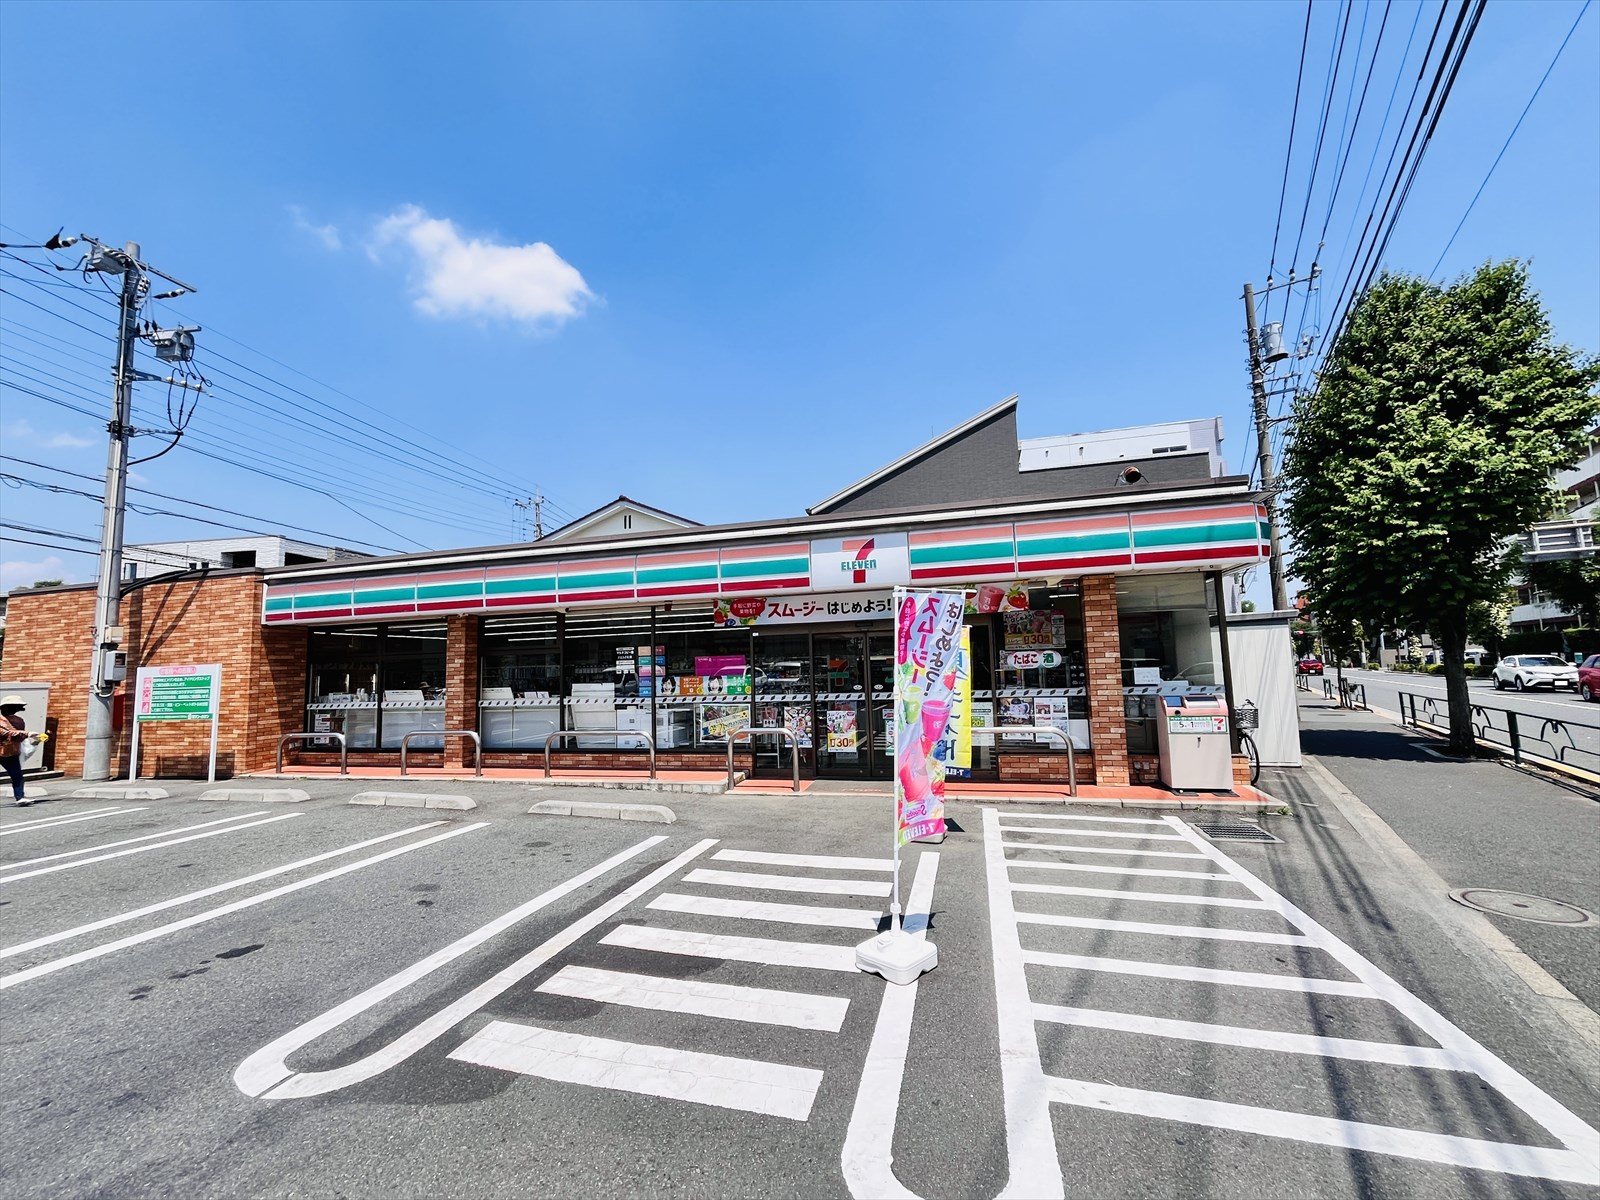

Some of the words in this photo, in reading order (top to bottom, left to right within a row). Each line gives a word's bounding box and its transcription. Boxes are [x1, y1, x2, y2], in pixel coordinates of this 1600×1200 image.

[842, 538, 874, 583] 7
[768, 602, 824, 618] スムージー
[827, 598, 892, 615] はじめよう!
[1013, 653, 1039, 665] たばこ
